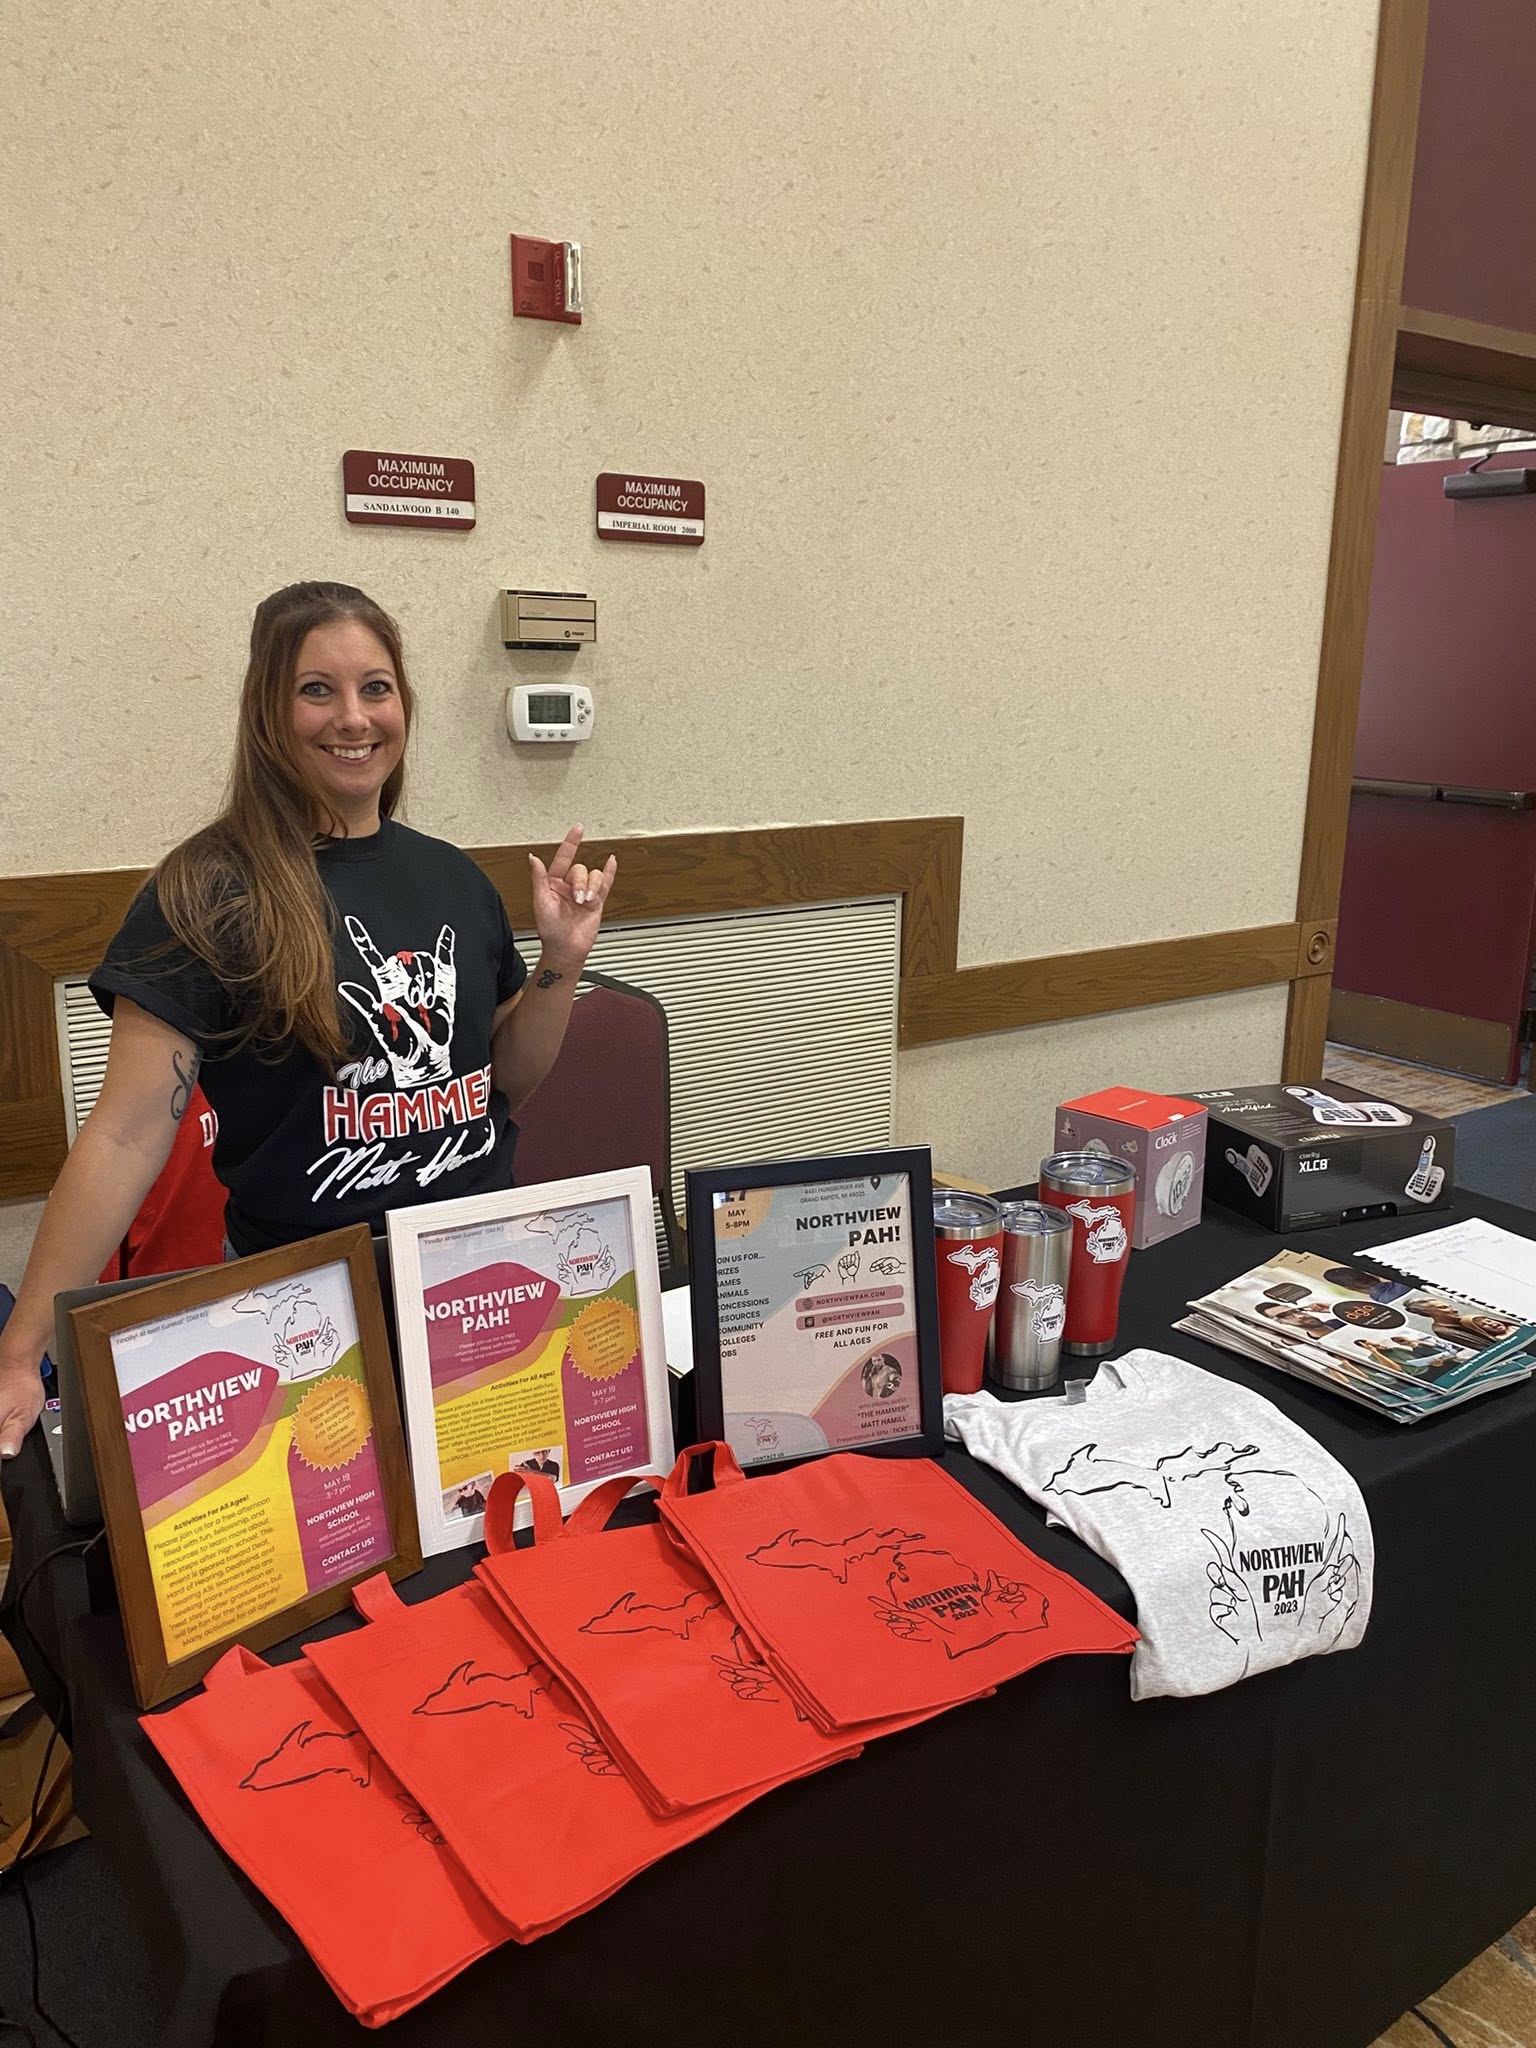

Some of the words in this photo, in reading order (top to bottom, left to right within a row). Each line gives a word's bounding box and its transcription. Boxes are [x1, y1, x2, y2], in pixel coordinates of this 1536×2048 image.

[377, 459, 445, 476] MAXIMUM
[368, 474, 454, 493] OCCUPANCY
[625, 481, 681, 497] MAXIMUM
[363, 502, 432, 515] SANDALWOOD
[435, 505, 442, 515] B
[446, 506, 460, 516] 140
[617, 495, 688, 512] OCCUPANCY
[612, 519, 651, 532] IMPERIAL
[652, 522, 677, 534] ROOM
[681, 525, 697, 535] 2000
[338, 1056, 390, 1089] The
[323, 1063, 491, 1147] HAMME
[1155, 1132, 1177, 1149] Clock
[1299, 1151, 1320, 1160] clarity
[306, 1142, 421, 1202] Matt
[1299, 1159, 1329, 1173] XLC8
[728, 1209, 746, 1217] MAY
[796, 1206, 901, 1230] NORTHVIEW
[726, 1220, 750, 1229] 5-8PM
[849, 1226, 900, 1246] PAH!
[576, 1262, 593, 1273] PAH
[717, 1256, 730, 1264] OIN
[718, 1267, 739, 1276] RIZES
[424, 1280, 546, 1321] NORTHVIEW
[719, 1289, 749, 1299] NIMALS
[816, 1291, 886, 1305] NORTHVIEWPAH.COM
[718, 1298, 770, 1311] ONCESSIONS
[462, 1307, 510, 1334] PAH!
[720, 1311, 760, 1322] ESOURCES
[822, 1310, 880, 1323] @NORTHVIEWPAH
[719, 1322, 764, 1334] OMMUNITY
[815, 1330, 835, 1340] FREE
[836, 1327, 853, 1336] AND
[855, 1325, 871, 1334] FUN
[873, 1322, 888, 1332] FOR
[295, 1338, 314, 1352] PAH
[834, 1340, 848, 1348] ALL
[850, 1336, 871, 1346] AGES
[721, 1349, 737, 1358] OBS
[491, 1380, 518, 1390] Activities
[539, 1370, 554, 1379] Ages!
[125, 1367, 263, 1434] NORTHVIEW
[592, 1388, 606, 1397] MAY
[574, 1409, 617, 1426] NORTHVIEW
[619, 1404, 636, 1413] HIGH
[858, 1410, 874, 1419] "THE
[875, 1405, 909, 1416] HAMMER"
[168, 1404, 225, 1442] PAH!
[592, 1419, 621, 1432] SCHOOL
[861, 1420, 880, 1428] MATT
[881, 1416, 906, 1426] HAMILL
[893, 1424, 914, 1433] TICKETS
[584, 1450, 619, 1464] CONTACT
[324, 1477, 340, 1490] MAY
[342, 1472, 350, 1482] 19
[326, 1488, 338, 1499] 3-7
[339, 1483, 351, 1494] pm
[174, 1512, 206, 1530] Activities
[207, 1507, 218, 1516] For
[230, 1494, 249, 1508] Ages!
[306, 1498, 355, 1526] NORTHVIEW
[356, 1489, 375, 1503] HIGH
[153, 1536, 178, 1551] Please
[179, 1529, 192, 1541] join
[204, 1520, 214, 1529] for
[222, 1511, 235, 1521] free
[236, 1496, 270, 1515] afternoon
[327, 1509, 360, 1529] SCHOOL
[164, 1545, 181, 1557] filled
[183, 1538, 198, 1549] with
[251, 1509, 264, 1520] and
[163, 1548, 198, 1569] resources
[209, 1536, 227, 1548] learn
[228, 1528, 246, 1540] more
[248, 1518, 268, 1531] about
[322, 1543, 361, 1567] CONTACT
[361, 1536, 374, 1548] US!
[161, 1569, 177, 1581] next
[178, 1559, 198, 1574] steps
[199, 1551, 216, 1563] after
[217, 1544, 233, 1557] high
[260, 1526, 273, 1536] This
[1239, 1541, 1324, 1572] NORTHVIEW
[166, 1587, 184, 1599] Hard
[186, 1582, 193, 1590] of
[261, 1546, 275, 1556] and
[169, 1573, 190, 1587] event
[199, 1558, 225, 1575] geared
[226, 1547, 250, 1562] toward
[172, 1590, 201, 1608] Hearing
[203, 1584, 214, 1594] ASL
[216, 1571, 244, 1588] learners
[246, 1563, 260, 1575] who
[262, 1557, 273, 1567] are
[1263, 1569, 1305, 1603] PAH
[903, 1582, 982, 1610] NORTHVIEW
[931, 1594, 981, 1618] PAH
[952, 1608, 979, 1621] 2023
[1274, 1600, 1299, 1616] 2023
